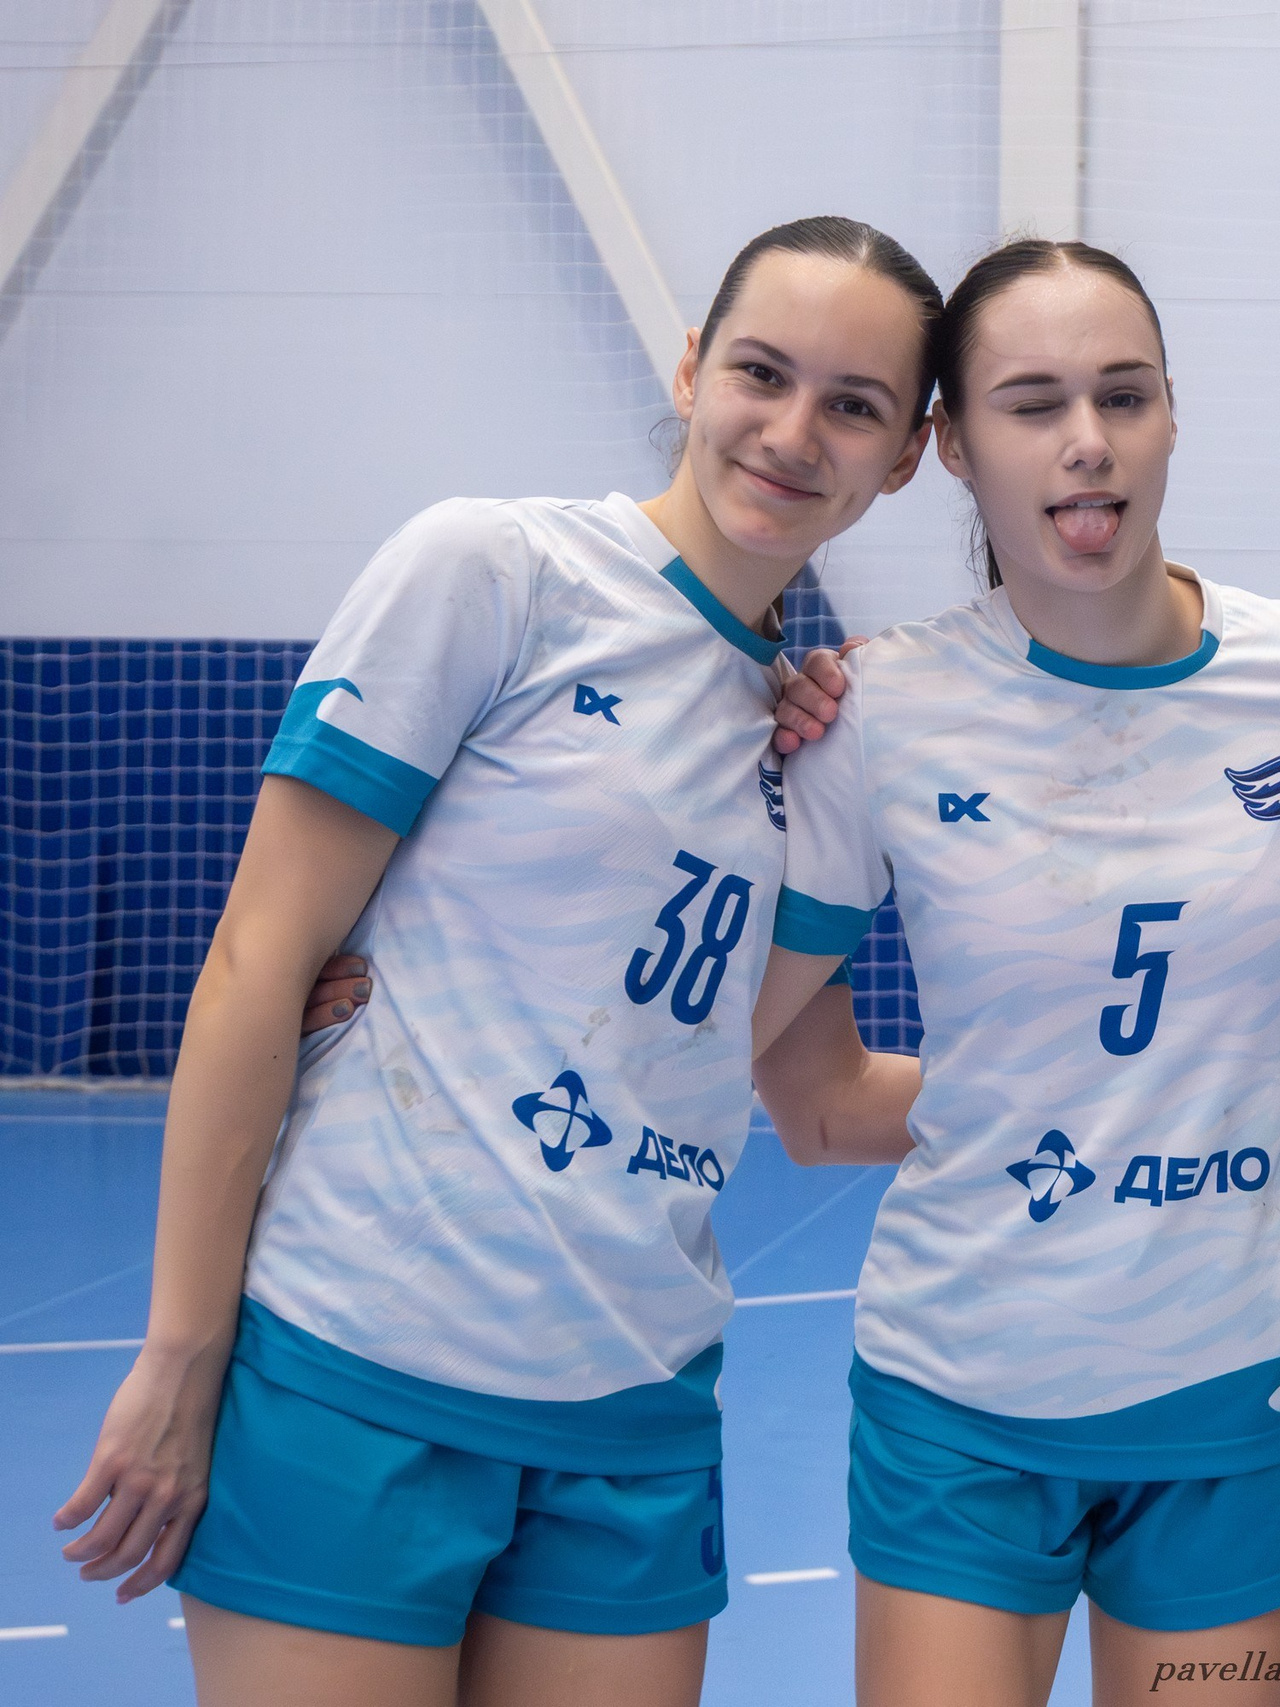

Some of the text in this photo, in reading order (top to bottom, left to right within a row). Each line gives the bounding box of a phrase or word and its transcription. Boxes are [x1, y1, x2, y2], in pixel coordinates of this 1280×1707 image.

[624, 849, 756, 1026] 38
[1099, 901, 1191, 1057] 5
[626, 1125, 725, 1192] ДЕЛО
[1113, 1146, 1271, 1208] ДЕЛО
